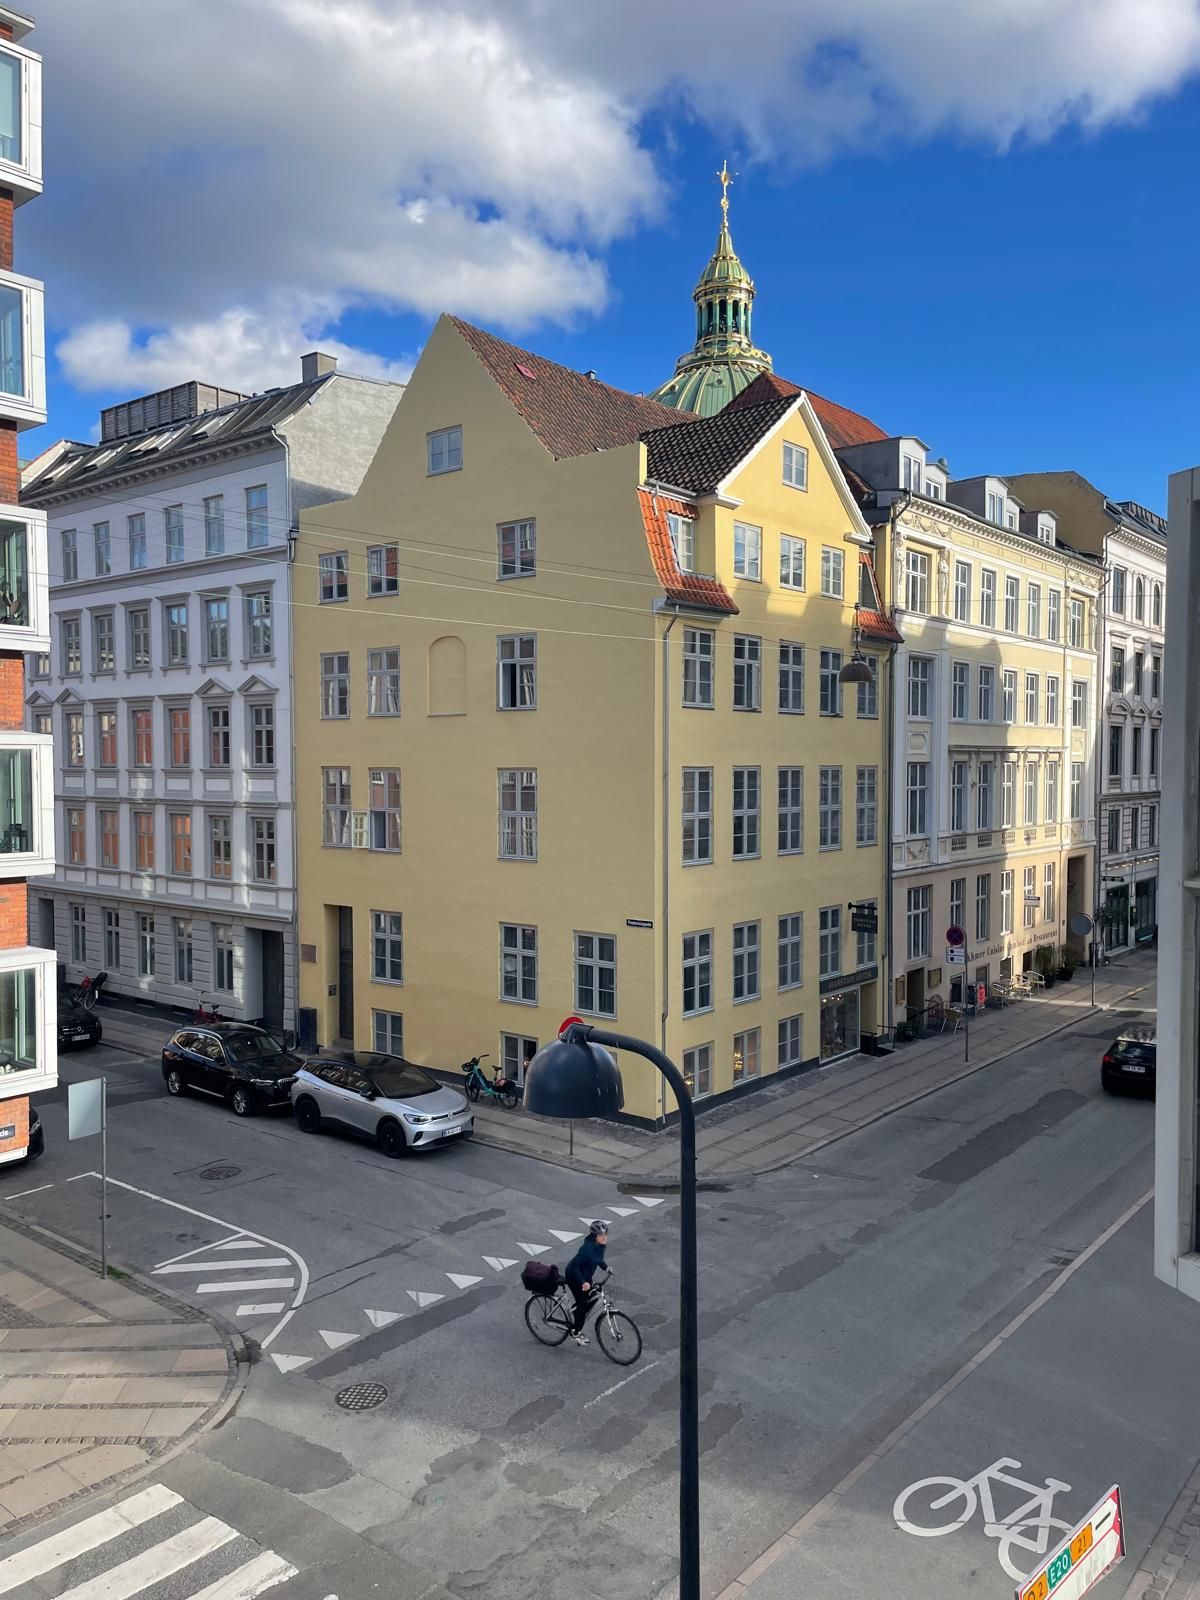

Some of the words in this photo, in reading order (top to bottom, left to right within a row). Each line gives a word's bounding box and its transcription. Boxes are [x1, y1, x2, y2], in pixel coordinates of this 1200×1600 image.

[1033, 929, 1058, 943] Restaurant
[856, 972, 872, 983] ANTIK
[1050, 1554, 1068, 1584] E20
[1078, 1535, 1086, 1555] 21
